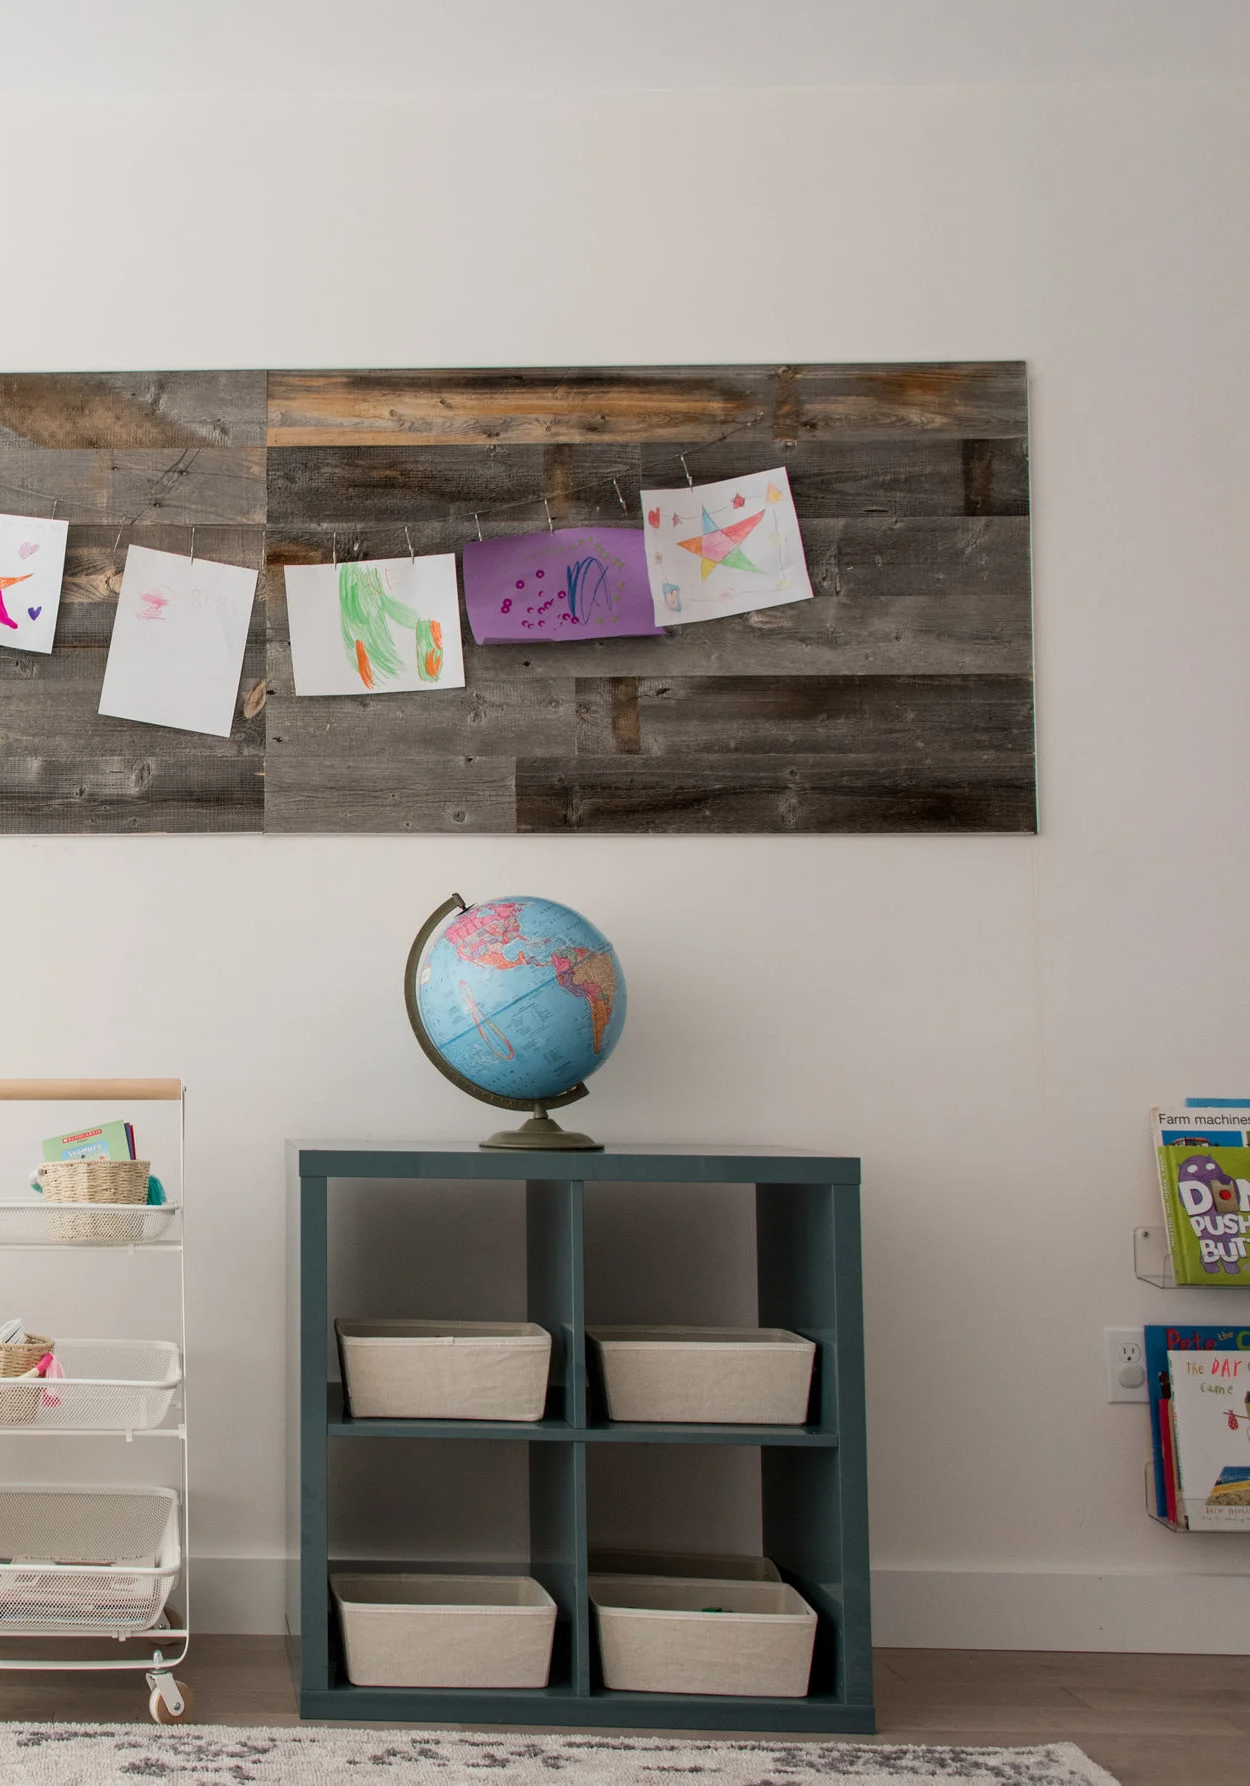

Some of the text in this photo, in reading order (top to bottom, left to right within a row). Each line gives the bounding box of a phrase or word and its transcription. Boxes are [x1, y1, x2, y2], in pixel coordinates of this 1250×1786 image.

[1158, 1113, 1190, 1125] Farm
[1199, 1236, 1250, 1264] BUT
[1166, 1327, 1217, 1351] Pete
[1217, 1331, 1234, 1342] the
[1186, 1361, 1204, 1375] The
